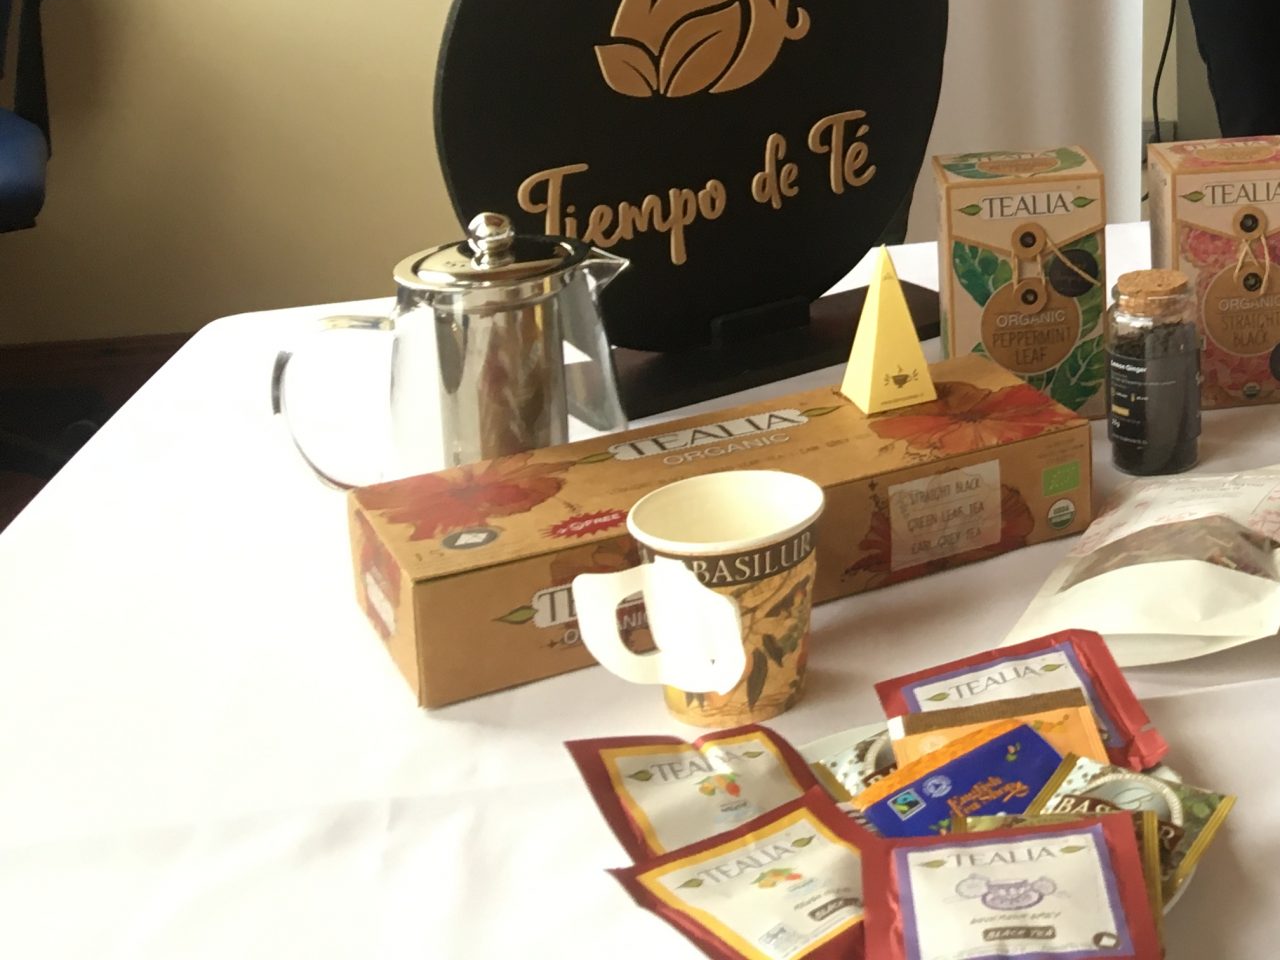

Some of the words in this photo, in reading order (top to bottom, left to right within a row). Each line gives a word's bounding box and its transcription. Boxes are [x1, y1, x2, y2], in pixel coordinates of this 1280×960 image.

[517, 162, 727, 266] Tiempo
[751, 132, 800, 210] de
[808, 109, 877, 195] Té
[982, 192, 1071, 218] TEALIA
[996, 310, 1066, 328] ORGANIC
[614, 413, 803, 456] TEALIA
[663, 432, 790, 466] ORGANIC
[692, 531, 811, 584] BASILUR
[949, 665, 1042, 699] TEALIA
[697, 844, 796, 883] TEALIA
[947, 846, 1056, 867] TEALIA
